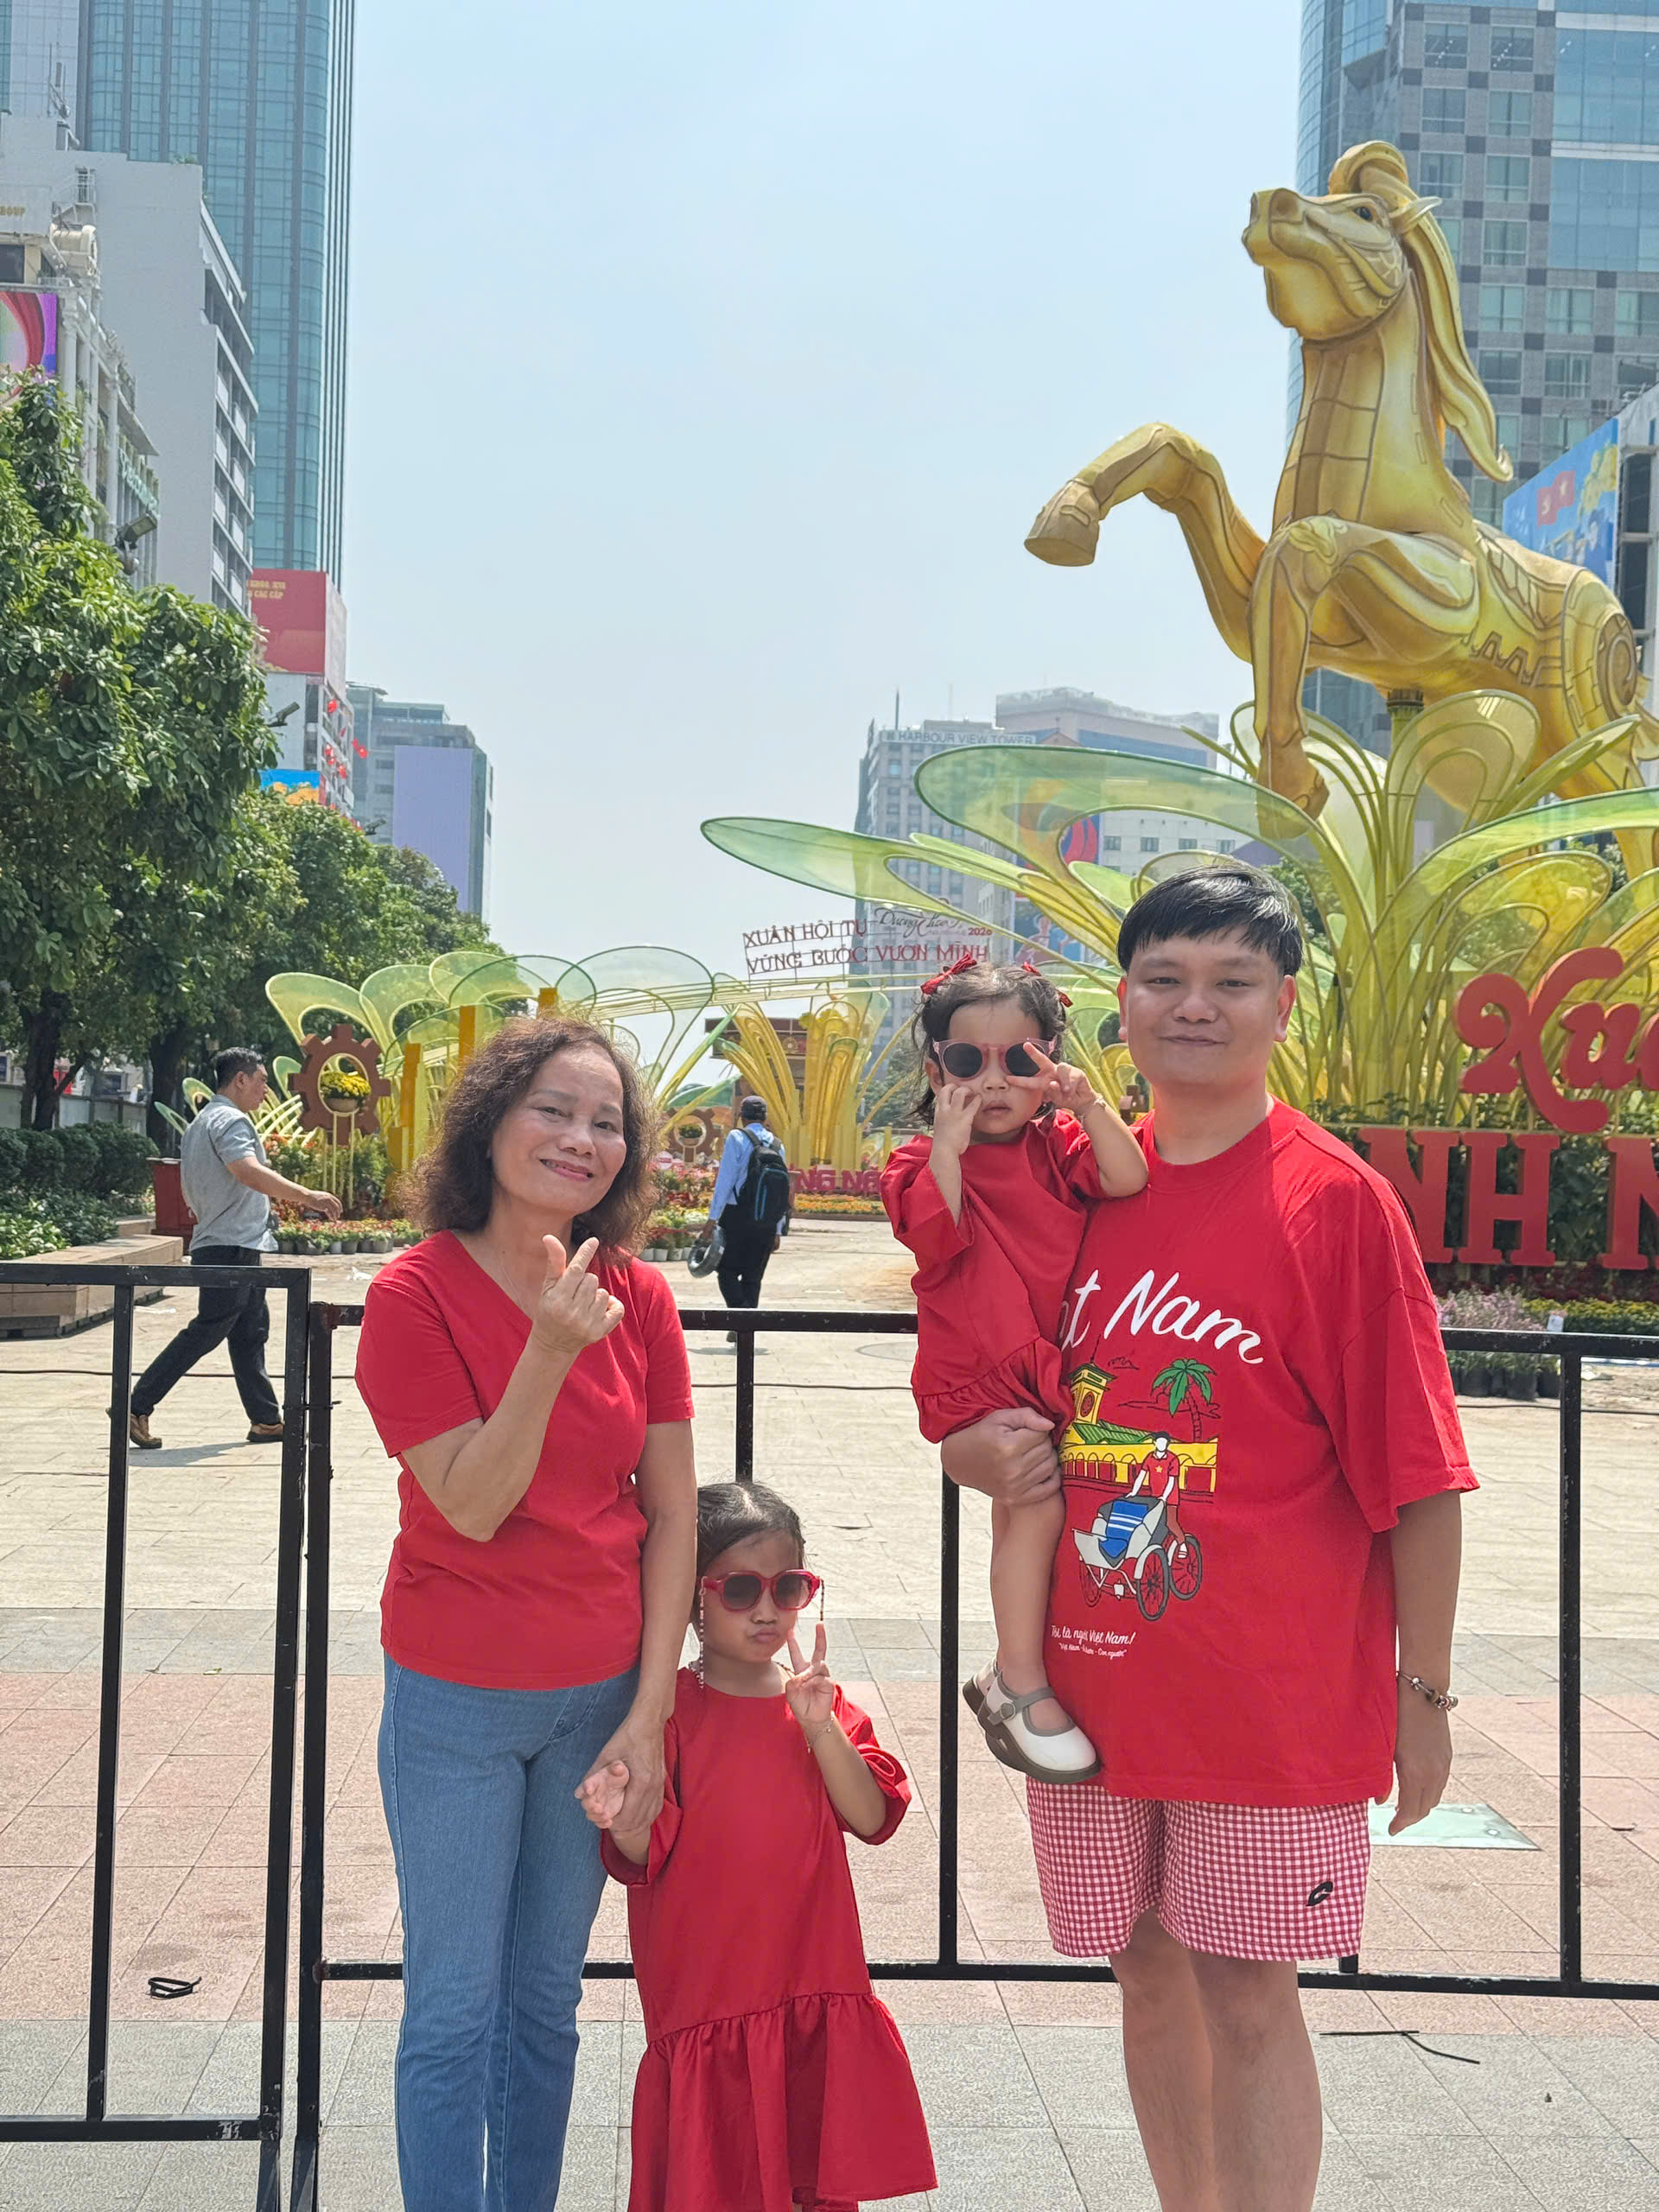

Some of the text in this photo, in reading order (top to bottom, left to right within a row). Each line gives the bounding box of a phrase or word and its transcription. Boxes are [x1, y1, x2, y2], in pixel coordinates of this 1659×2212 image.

[899, 733, 1033, 745] HARBOUR VIEW TOWER
[743, 919, 867, 949] XUÂN HỘI TỤ
[968, 927, 993, 937] 2026
[1453, 946, 1659, 1134] Xu
[1103, 1269, 1264, 1364] Nam
[1062, 1625, 1072, 1639] là
[1089, 1630, 1104, 1646] Việt
[1105, 1630, 1137, 1645] Nam!
